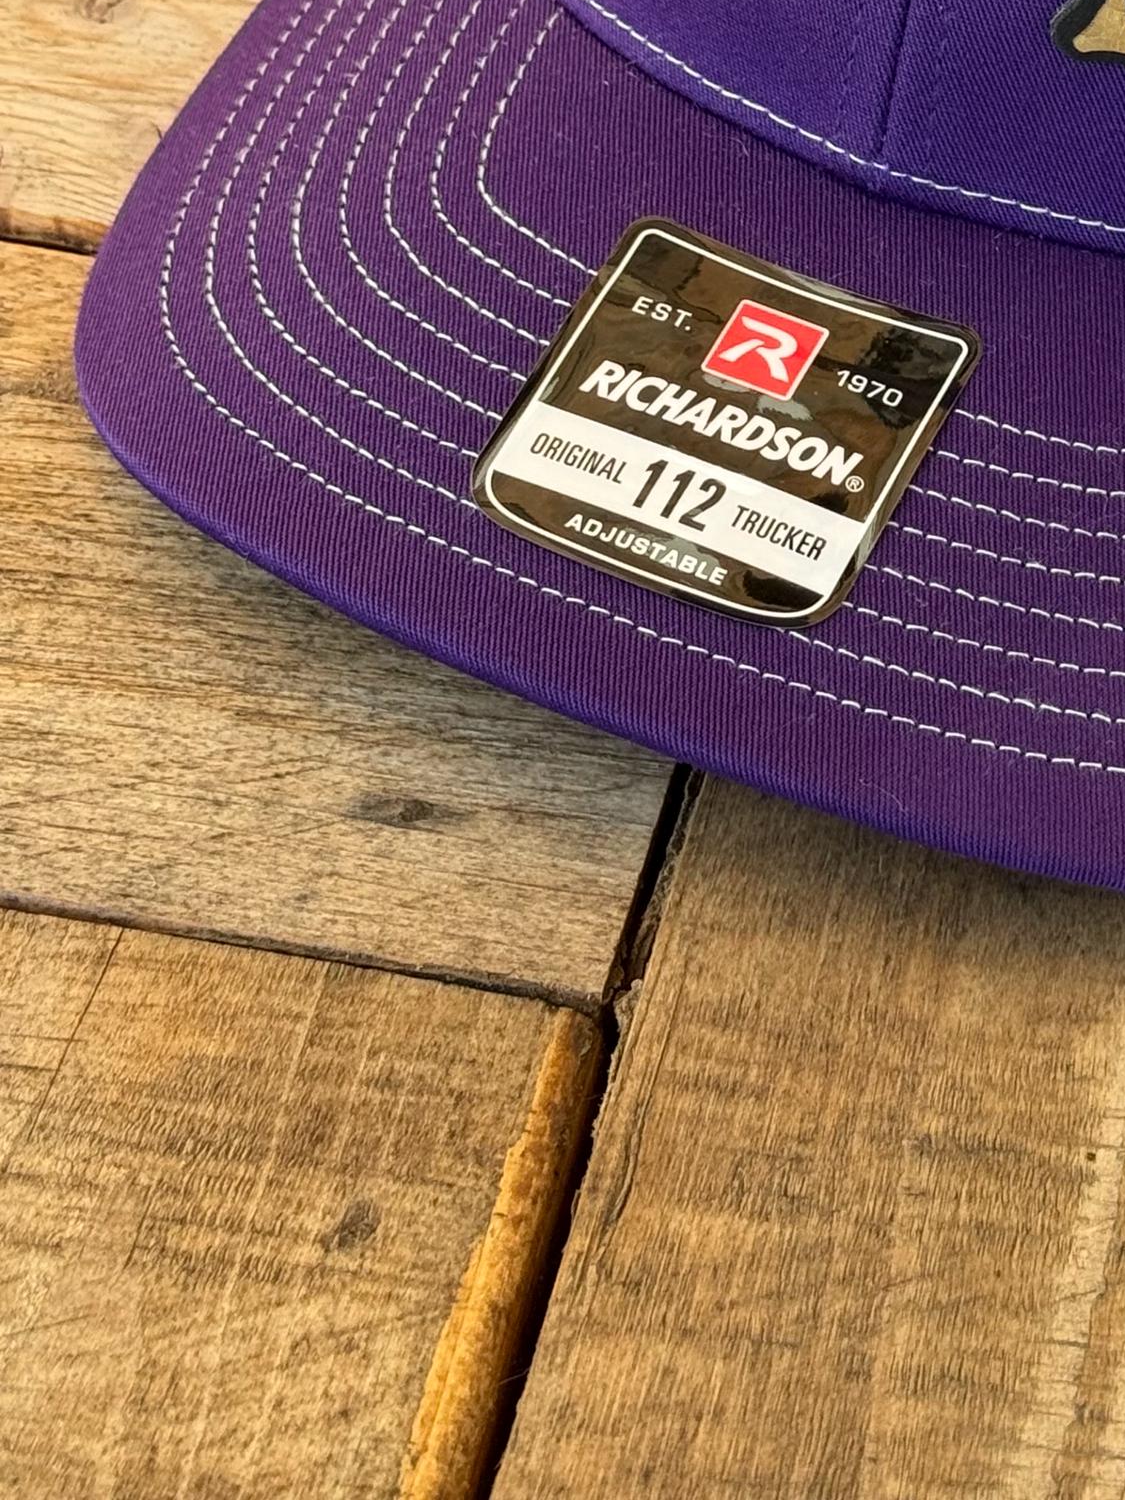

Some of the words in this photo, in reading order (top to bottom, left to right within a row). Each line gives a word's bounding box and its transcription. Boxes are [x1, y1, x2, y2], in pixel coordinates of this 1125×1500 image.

[631, 296, 694, 332] EST.
[834, 368, 904, 408] 1970
[530, 432, 628, 485] ORIGINAL
[632, 458, 727, 532] 112
[731, 504, 828, 561] TRUCKER
[564, 513, 729, 588] ADJUSTABLE
